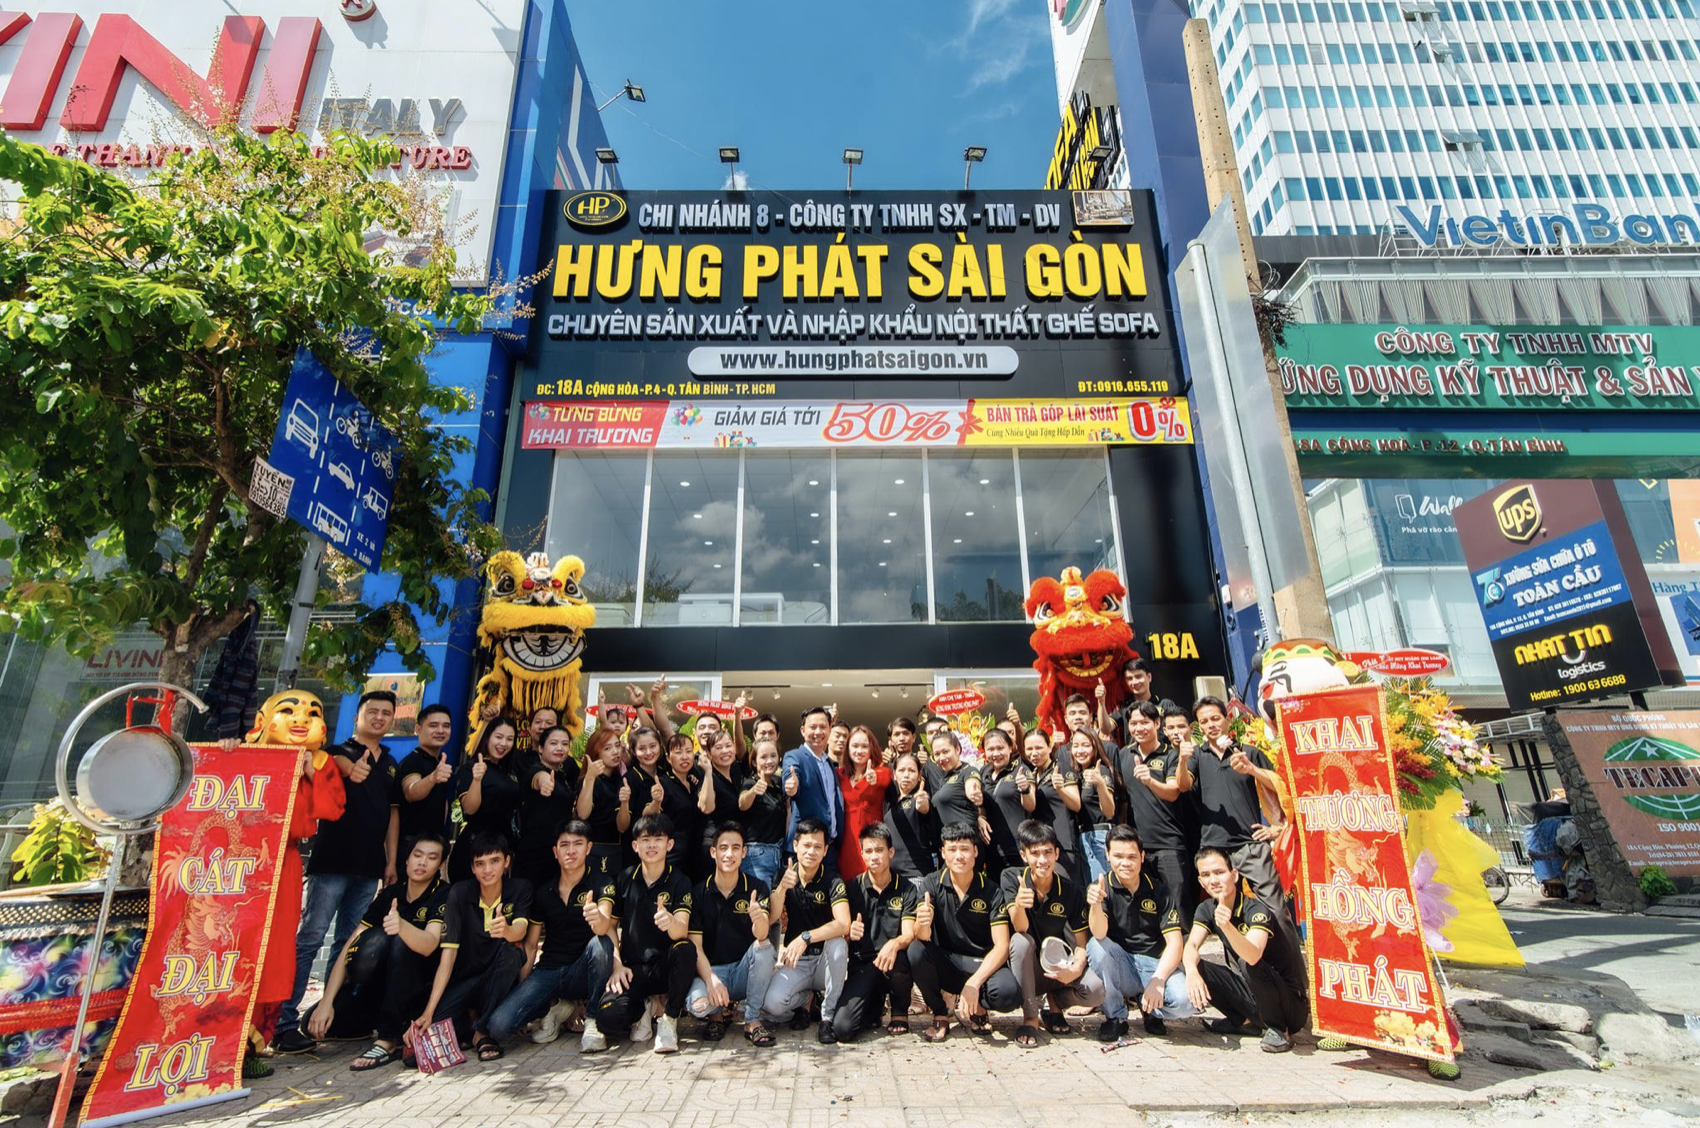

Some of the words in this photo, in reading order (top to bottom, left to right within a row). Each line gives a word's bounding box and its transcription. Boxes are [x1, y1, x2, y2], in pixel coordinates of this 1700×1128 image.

[0, 11, 322, 133] INI
[577, 197, 610, 215] HP
[638, 203, 674, 227] CHI
[678, 199, 750, 227] NHÁNH
[756, 204, 769, 227] 8
[789, 199, 845, 227] CÔNG
[850, 203, 873, 227] TY
[879, 203, 934, 227] TNHH
[939, 203, 968, 226] SX
[984, 203, 1016, 226] TM
[1035, 203, 1060, 226] DV
[1395, 203, 1700, 249] VietinBan
[552, 239, 723, 298] HƯNG
[742, 232, 888, 298] PHÁT
[908, 232, 1007, 297] SÀI
[1025, 230, 1148, 297] GÒN
[548, 308, 642, 335] CHUYÊN
[646, 307, 694, 335] SẢN
[699, 306, 761, 335] XUẤT
[766, 308, 801, 335] VÀ
[803, 307, 865, 340] NHẬP
[869, 303, 933, 334] KHẨU
[937, 307, 977, 339] NỘI
[980, 305, 1042, 334] THẤT
[1048, 304, 1096, 334] GHẾ
[1099, 312, 1160, 334] SOFA
[1374, 326, 1456, 355] CÔNG
[1461, 332, 1499, 355] TY
[1505, 333, 1587, 355] TNHH
[1588, 332, 1652, 355] MTV
[720, 350, 988, 371] www.hungphatsaigon.vn
[537, 384, 555, 395] ĐC:
[557, 379, 583, 395] 18A
[586, 381, 615, 397] CỘNG
[679, 381, 700, 395] TÂN
[752, 383, 776, 395] HCM
[1278, 357, 1342, 395] ỨNG
[1345, 365, 1434, 403] DỤNG
[1435, 358, 1480, 396] KỸ
[1486, 358, 1589, 404] THUẬT
[1594, 365, 1625, 396] &
[1624, 356, 1694, 396] SẢN
[597, 403, 643, 422] BỪNG
[714, 408, 756, 426] GIẢM
[760, 407, 787, 426] GIÁ
[793, 407, 821, 425] TỚI
[821, 403, 951, 443] 50%
[987, 404, 1012, 422] BÁN
[1014, 402, 1037, 422] TRẢ
[1040, 404, 1064, 422] GÓP
[1068, 403, 1086, 422] LÃI
[1090, 401, 1119, 422] SUẤT
[1130, 400, 1187, 440] 0%
[527, 428, 571, 444] KHAI
[577, 427, 654, 444] TRƯƠNG
[1326, 436, 1373, 454] CỘNG
[1375, 435, 1411, 452] HOÀ
[1525, 436, 1565, 452] BÌNH
[1499, 498, 1536, 533] ups
[1513, 579, 1560, 607] TOÀN
[1561, 564, 1602, 591] CẦU
[1652, 581, 1688, 594] Hàng
[1149, 632, 1200, 660] 18A
[1568, 624, 1613, 650] TIN
[1557, 660, 1606, 679] logistics
[1530, 688, 1562, 702] Hotline:
[1563, 682, 1587, 695] 1900
[1587, 679, 1601, 690] 63
[1600, 674, 1626, 688] 6688
[1289, 715, 1378, 754] KHAI
[186, 775, 270, 820] ĐẠI
[1299, 791, 1399, 832] TRƯƠNG
[1657, 823, 1677, 832] ISO
[177, 847, 255, 894] CÁT
[1311, 867, 1416, 930] HỒNG
[154, 951, 240, 1005] ĐẠI
[1318, 954, 1428, 1013] PHÁT
[123, 1032, 216, 1097] LỢI
